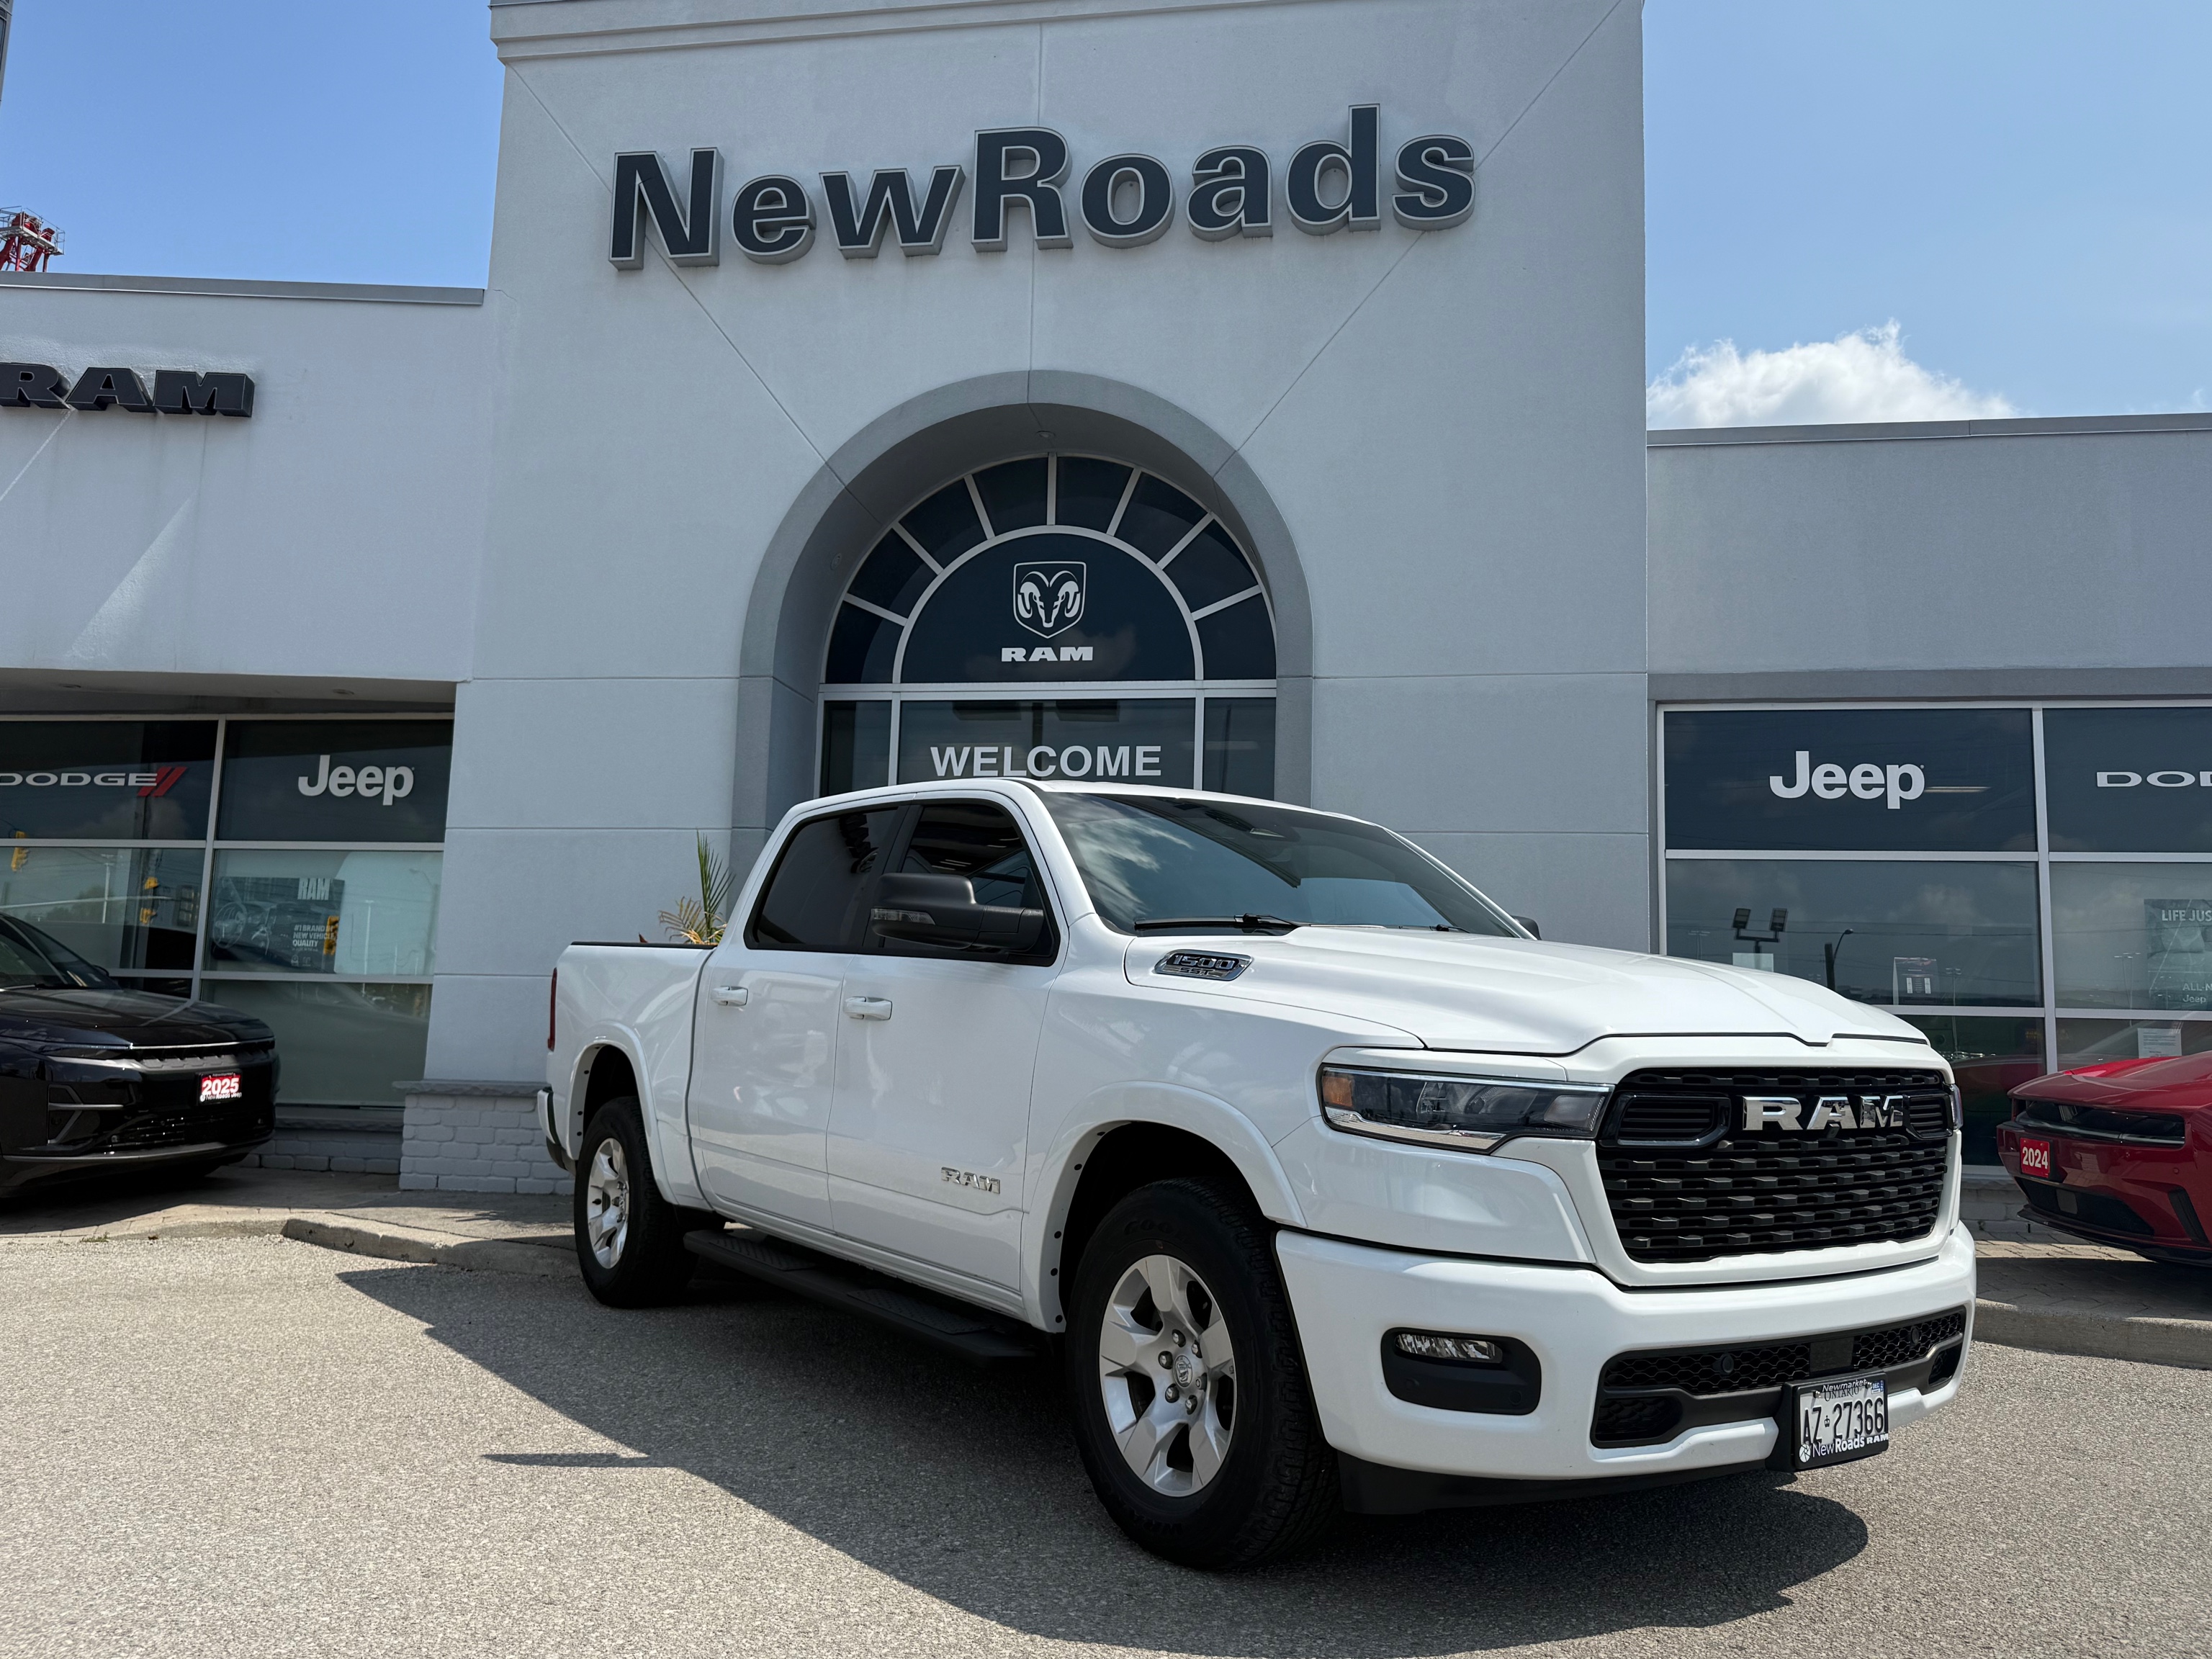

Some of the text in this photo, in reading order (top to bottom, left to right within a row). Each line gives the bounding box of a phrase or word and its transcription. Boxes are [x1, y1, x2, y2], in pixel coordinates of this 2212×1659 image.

[0, 361, 255, 418] RAM
[1001, 646, 1094, 662] RAM
[930, 745, 1162, 778] WELCOME
[0, 772, 158, 787] DODGE
[297, 754, 415, 806] Jeep
[1768, 750, 1926, 809] Jeep
[2096, 770, 2212, 788] DO
[297, 878, 331, 901] RAM
[2161, 909, 2186, 922] LIFE
[292, 939, 319, 948] QUALITY
[1172, 954, 1236, 971] 1500
[2182, 994, 2206, 1004] Jeep
[202, 1077, 240, 1095] 2025
[1742, 1095, 1904, 1130] RAM
[2022, 1146, 2049, 1169] 2024
[940, 1166, 1001, 1195] RAM
[1822, 1378, 1867, 1393] Newmarket
[1833, 1397, 1884, 1441] 27366
[1866, 1433, 1889, 1444] RAM
